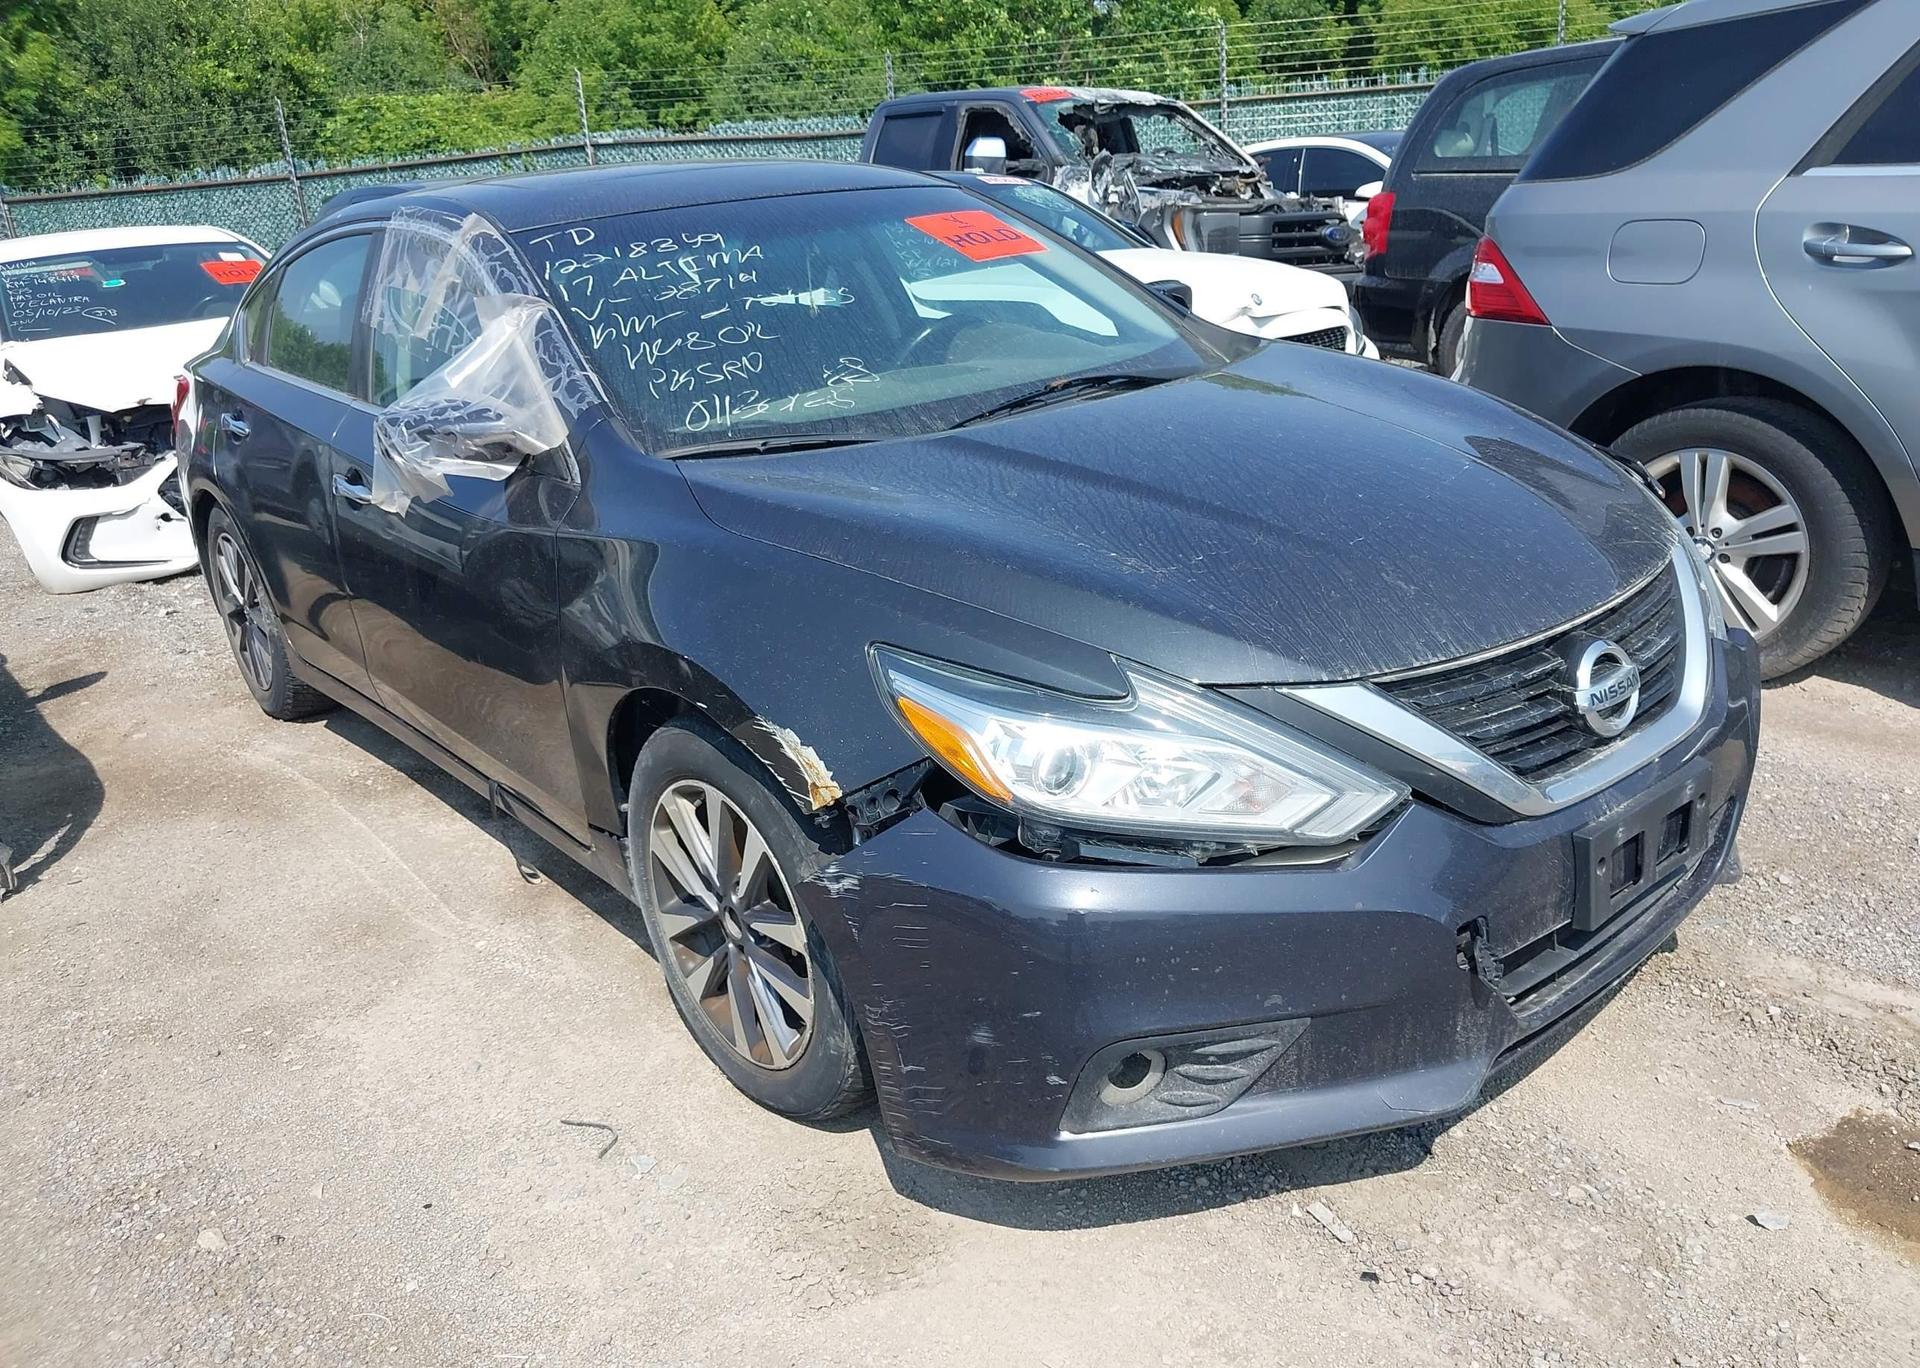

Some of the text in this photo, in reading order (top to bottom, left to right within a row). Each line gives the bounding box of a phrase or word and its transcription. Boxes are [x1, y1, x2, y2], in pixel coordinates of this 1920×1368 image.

[944, 228, 1022, 248] HOLD
[28, 296, 91, 308] ELANTRA
[1589, 673, 1639, 707] NISSAN
